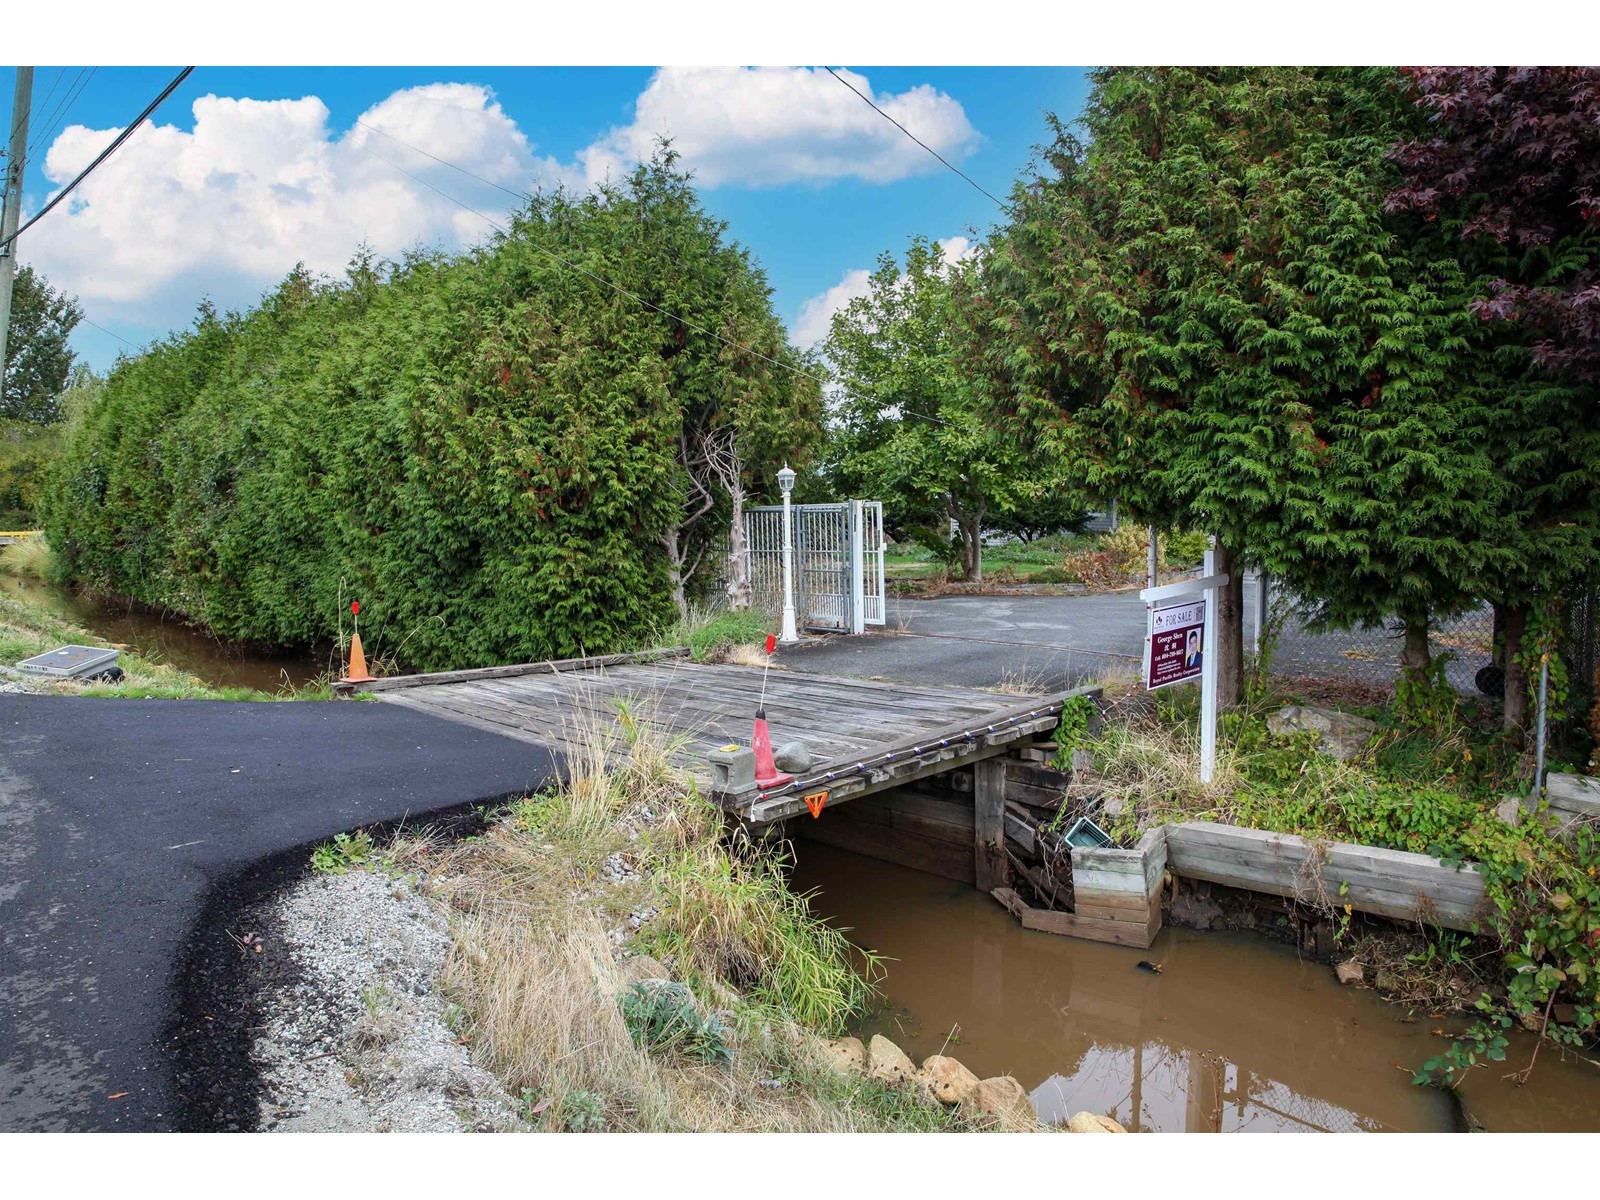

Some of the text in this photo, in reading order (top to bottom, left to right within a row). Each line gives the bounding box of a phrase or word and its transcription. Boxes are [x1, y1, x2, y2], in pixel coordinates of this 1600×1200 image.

[1166, 611, 1192, 626] FOR SALE
[1183, 667, 1200, 675] Corporation
